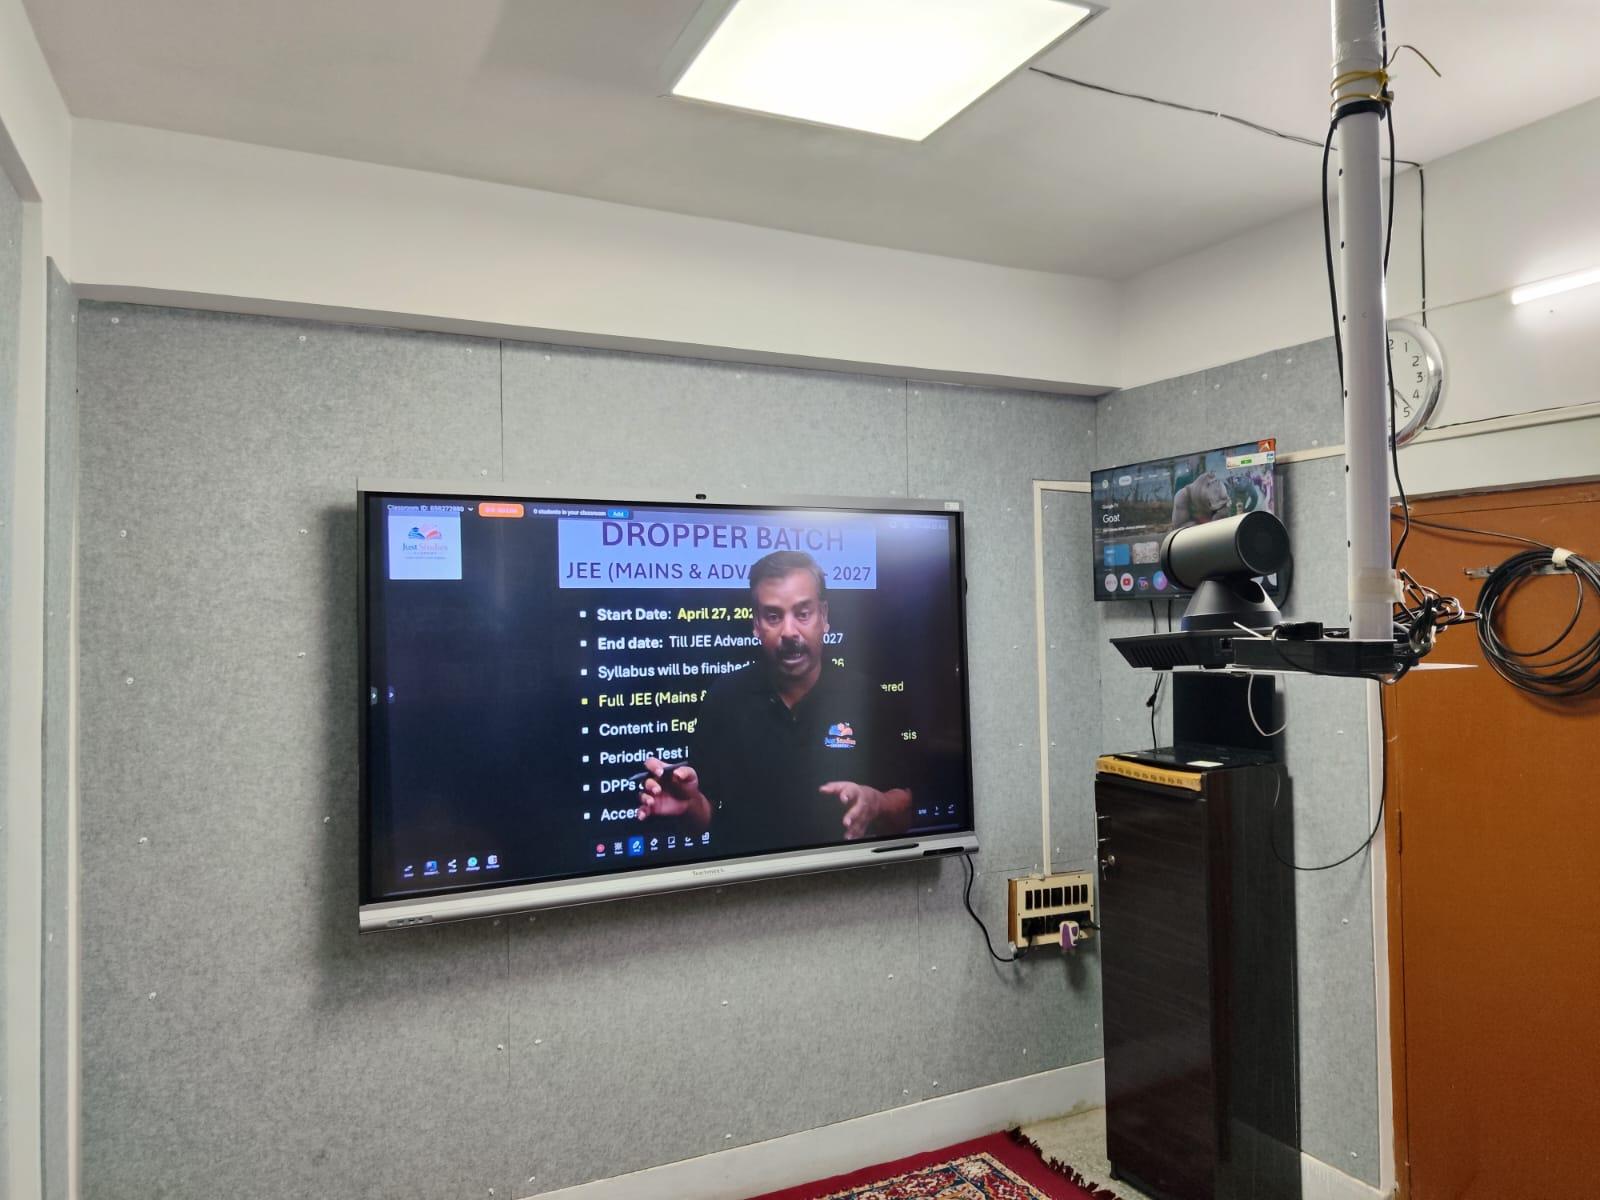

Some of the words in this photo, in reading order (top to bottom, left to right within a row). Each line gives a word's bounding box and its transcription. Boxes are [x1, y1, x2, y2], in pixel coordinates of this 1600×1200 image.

[1404, 342, 1408, 352] 1
[1412, 355, 1420, 367] 2
[1416, 371, 1424, 383] 3
[1412, 388, 1420, 399] 4
[1403, 406, 1411, 418] 5
[538, 508, 561, 516] students
[567, 509, 579, 517] your
[1103, 513, 1120, 523] Goat
[602, 521, 748, 549] DROPPER
[756, 524, 844, 551] BATCH
[566, 562, 601, 579] JEE
[608, 562, 683, 583] (MAINS
[689, 563, 702, 579] &
[833, 566, 871, 581] 2027
[597, 608, 632, 621] Start
[635, 608, 672, 621] Date:
[677, 607, 709, 622] April
[711, 607, 731, 621] 27,
[598, 637, 625, 650] End
[628, 637, 663, 649] date:
[669, 635, 688, 648] Till
[690, 635, 712, 648] JEE
[822, 632, 844, 644] 027
[598, 664, 655, 681] Syllabus
[657, 663, 681, 677] will
[683, 663, 699, 675] be
[598, 693, 625, 708] Full
[629, 692, 652, 706] JEE
[655, 691, 698, 707] (Mains
[599, 721, 654, 736] Content
[656, 720, 668, 733] in
[671, 717, 698, 734] Eng
[600, 749, 654, 765] Periodic
[656, 746, 682, 760] Test
[600, 778, 636, 794] DPPs
